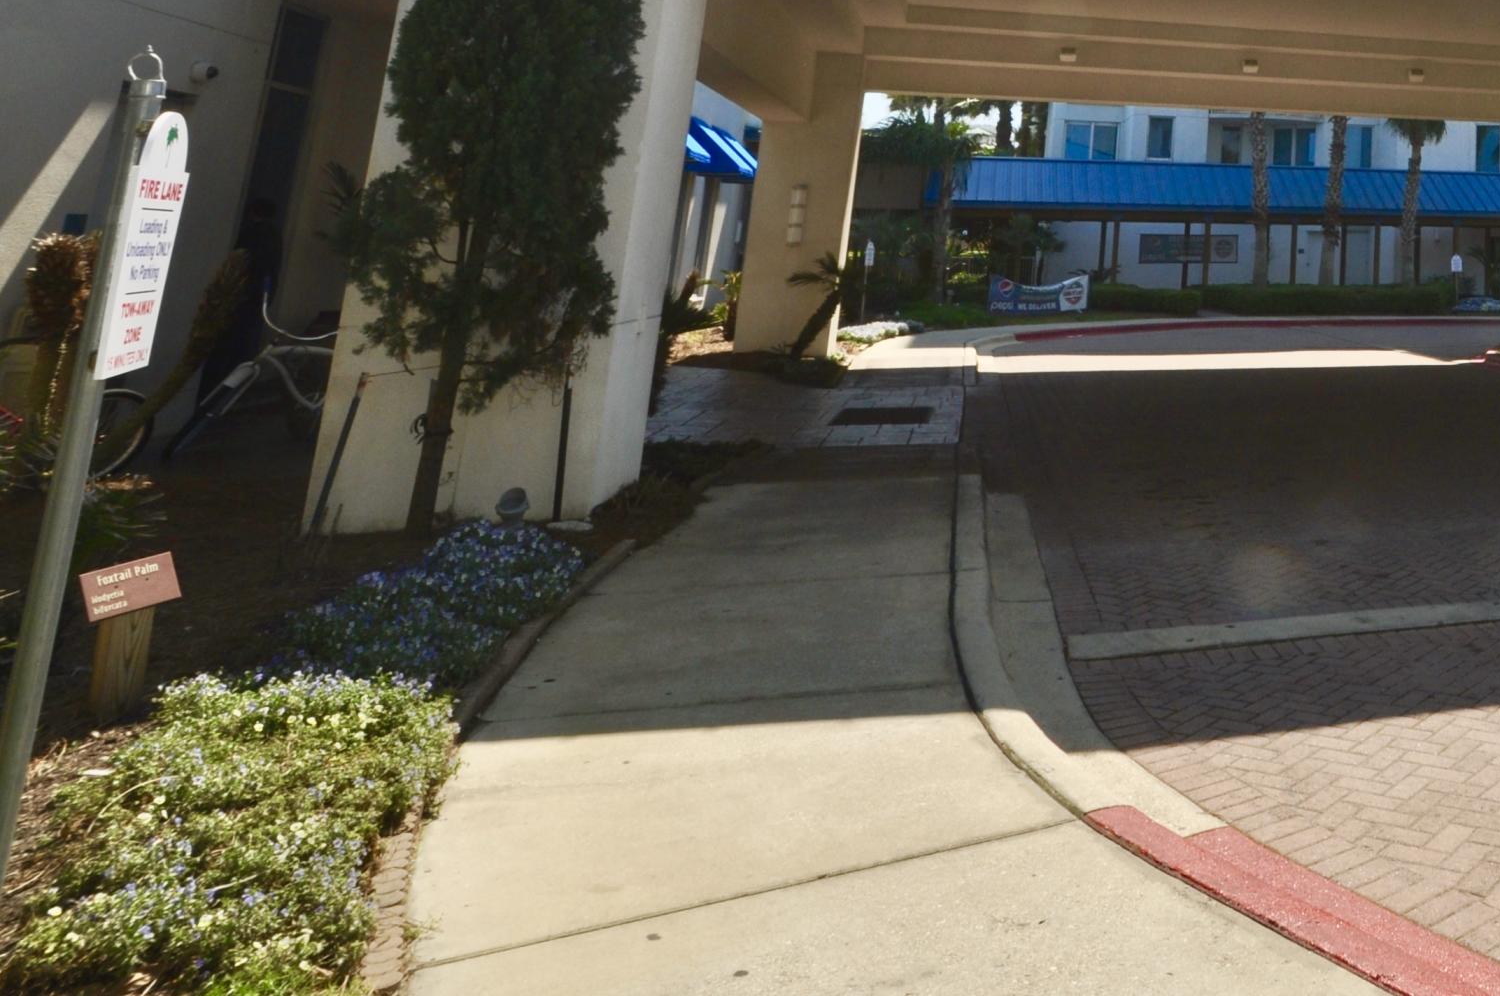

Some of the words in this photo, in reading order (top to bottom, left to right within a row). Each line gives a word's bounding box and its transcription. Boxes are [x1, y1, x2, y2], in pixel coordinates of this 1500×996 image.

[139, 178, 161, 199] FIRE
[161, 181, 183, 202] LANE
[139, 218, 163, 238] Loading
[126, 241, 156, 260] Unloading
[156, 241, 171, 257] ONLY
[129, 265, 138, 281] No
[139, 264, 160, 283] Parking
[121, 300, 155, 319] TOW-AWAY
[1029, 301, 1057, 311] DELIVER
[123, 326, 142, 345] ZONE
[96, 568, 132, 586] Foxtail
[134, 563, 159, 576] Palm
